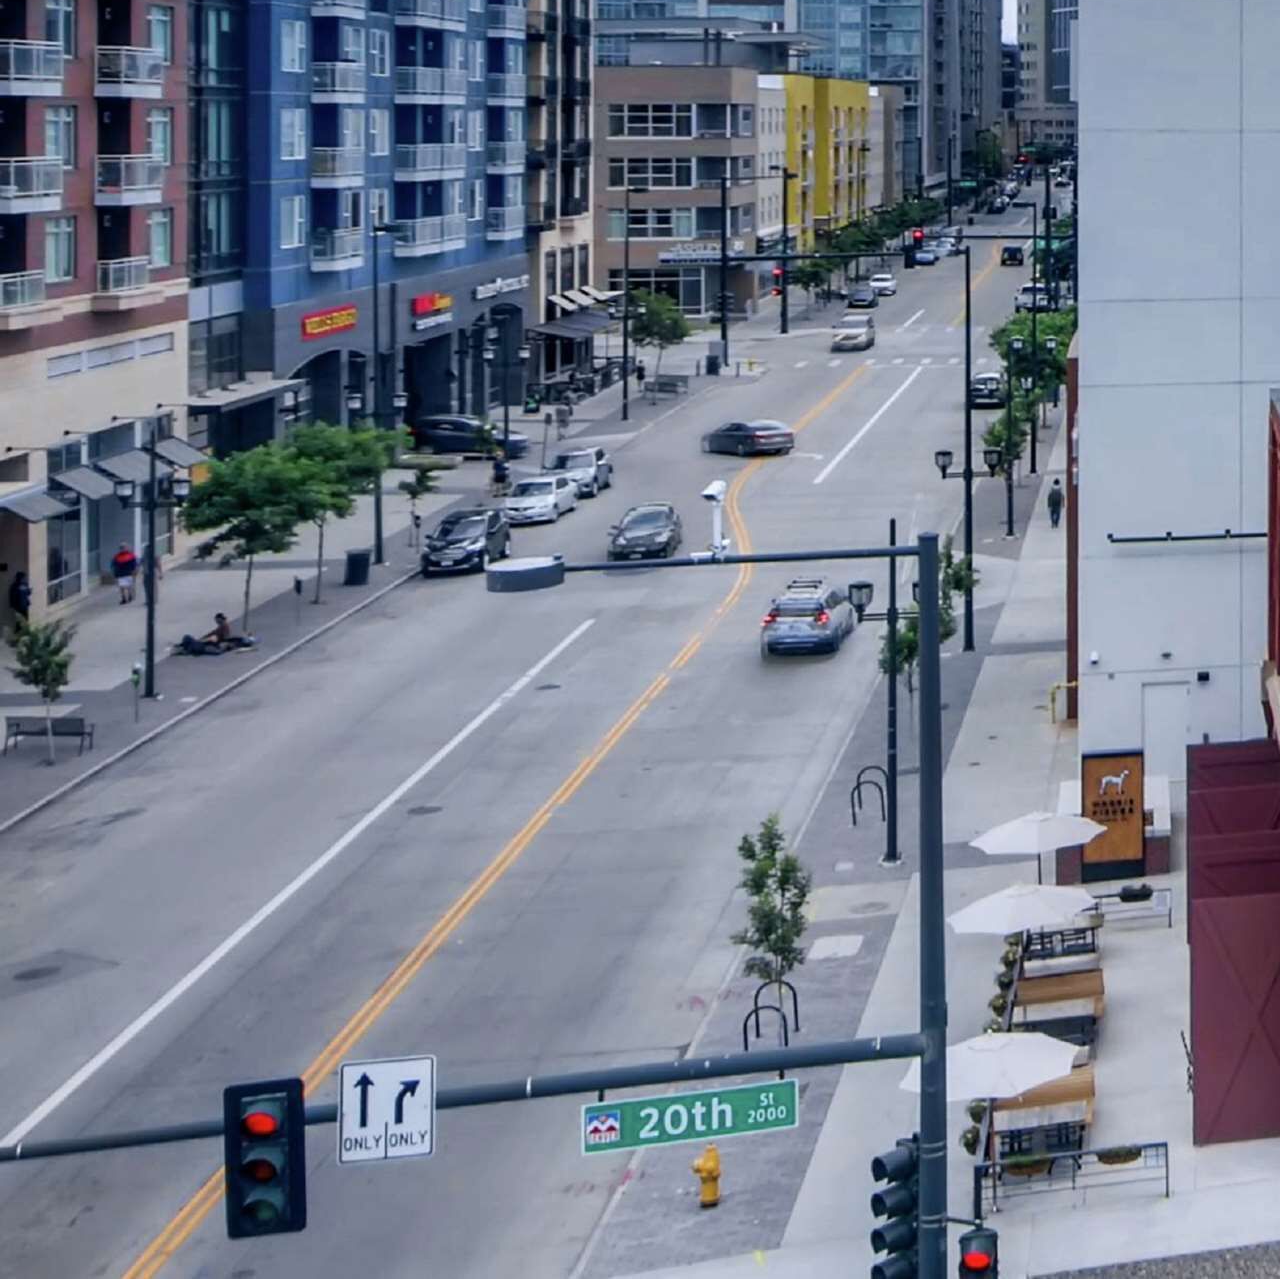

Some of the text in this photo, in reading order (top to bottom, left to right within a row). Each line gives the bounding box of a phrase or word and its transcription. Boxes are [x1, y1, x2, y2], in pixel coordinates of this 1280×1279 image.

[638, 1092, 774, 1139] 20th St
[747, 1105, 787, 1124] 2000
[343, 1134, 383, 1152] ONLY
[389, 1129, 428, 1148] ONLY
